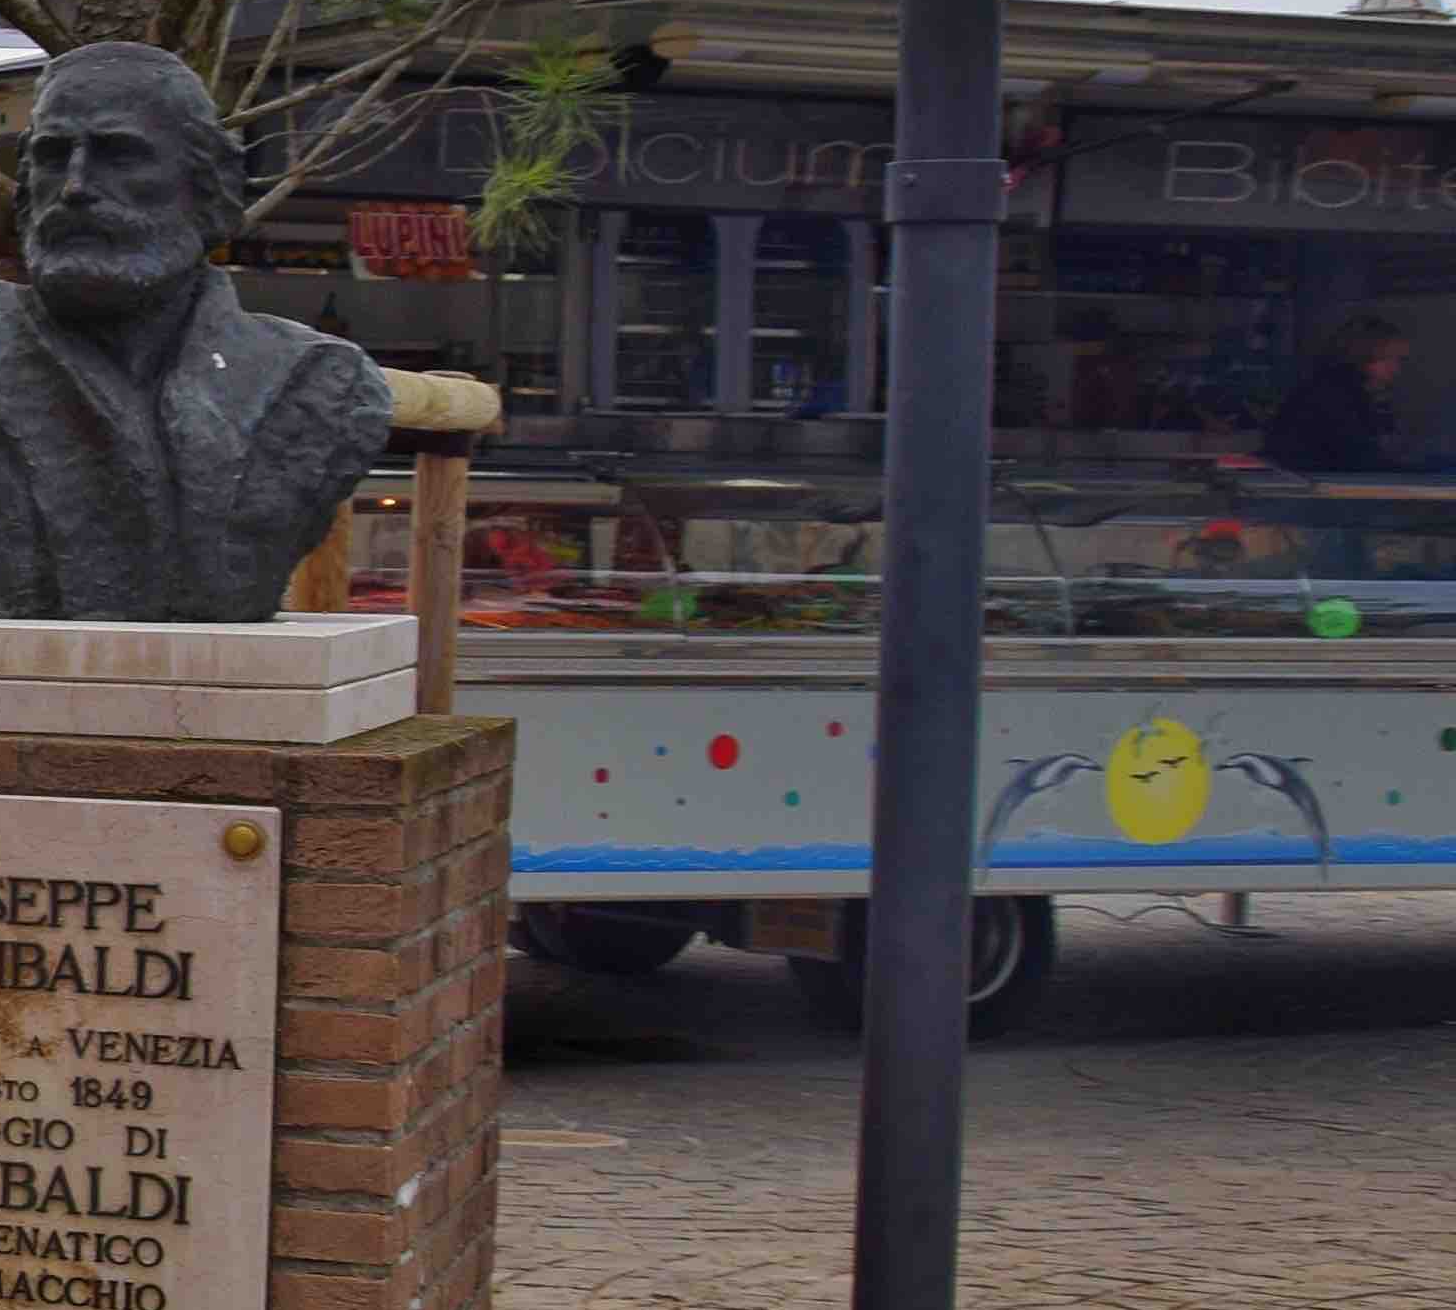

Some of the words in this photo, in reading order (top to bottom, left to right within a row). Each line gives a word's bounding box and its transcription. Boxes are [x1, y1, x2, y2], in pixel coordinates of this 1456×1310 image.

[352, 210, 465, 261] LUPINI
[28, 1036, 44, 1057] A
[66, 1028, 242, 1070] VENEZIA
[70, 1076, 153, 1111] 1849
[125, 1125, 168, 1160] DI
